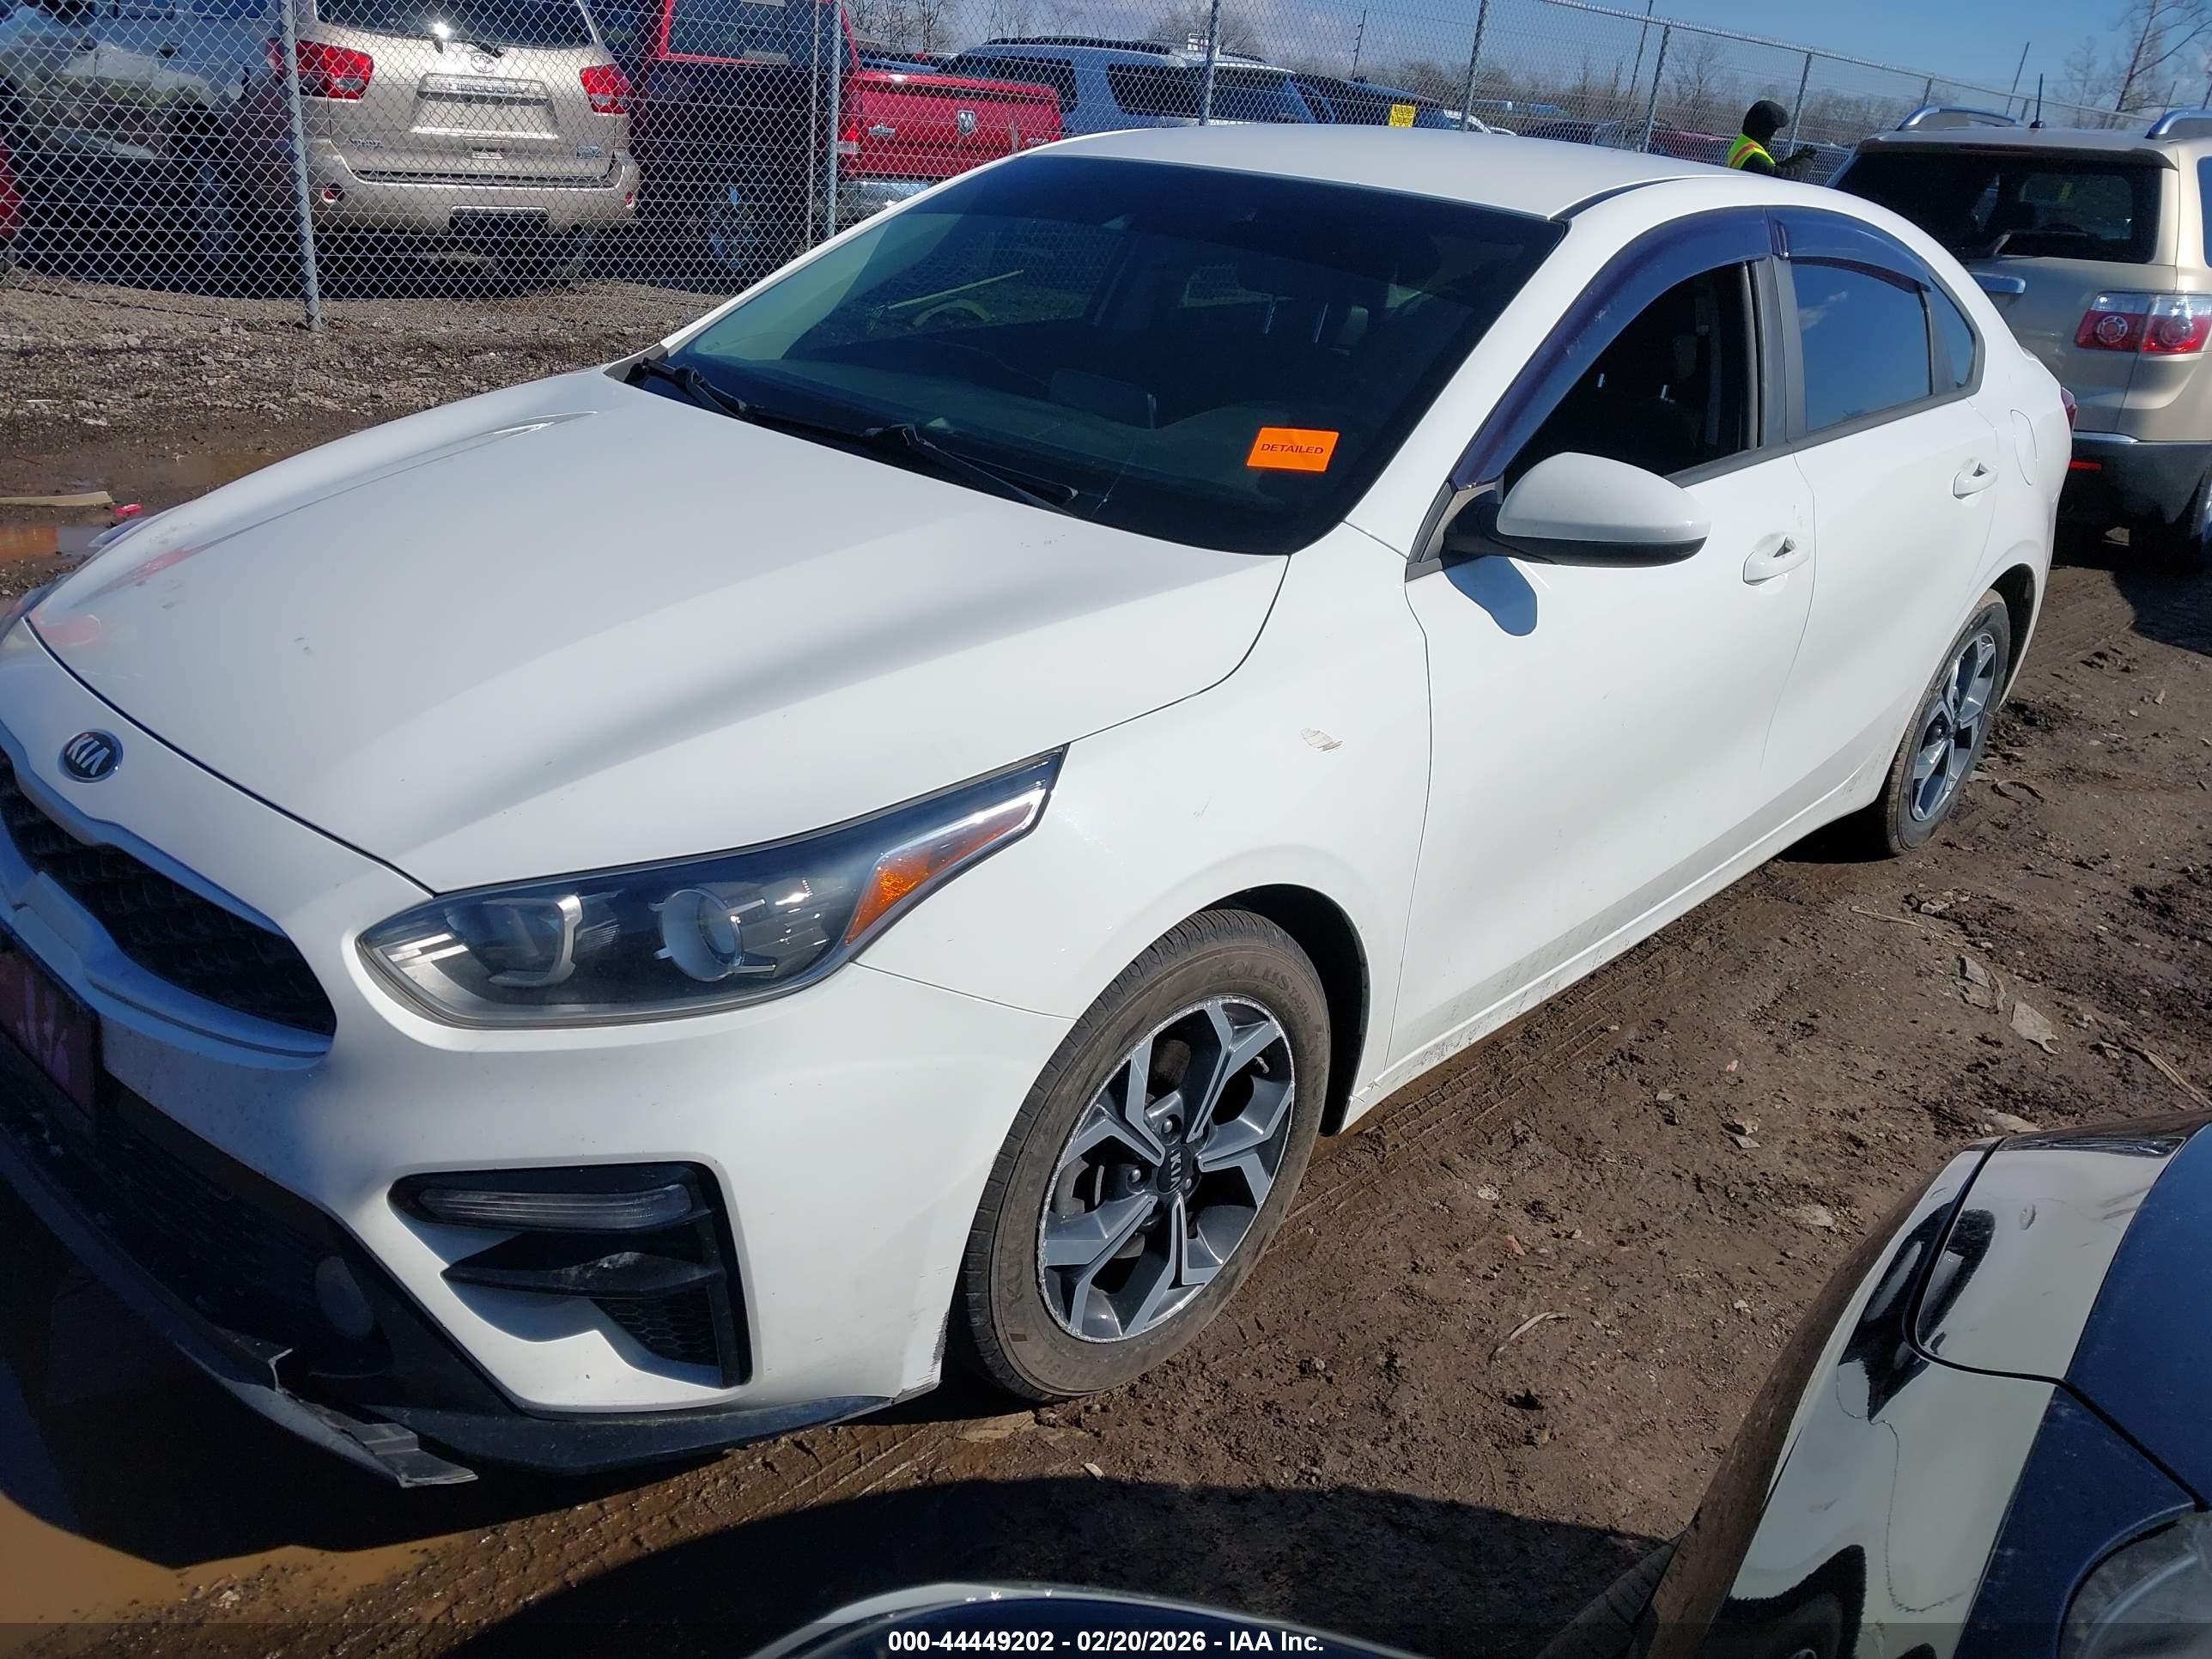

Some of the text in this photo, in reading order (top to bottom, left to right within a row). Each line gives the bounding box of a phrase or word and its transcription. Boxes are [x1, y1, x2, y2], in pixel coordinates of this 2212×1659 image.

[1261, 443, 1324, 454] DETAILED
[66, 733, 111, 776] KIA
[1170, 1151, 1182, 1190] KIA
